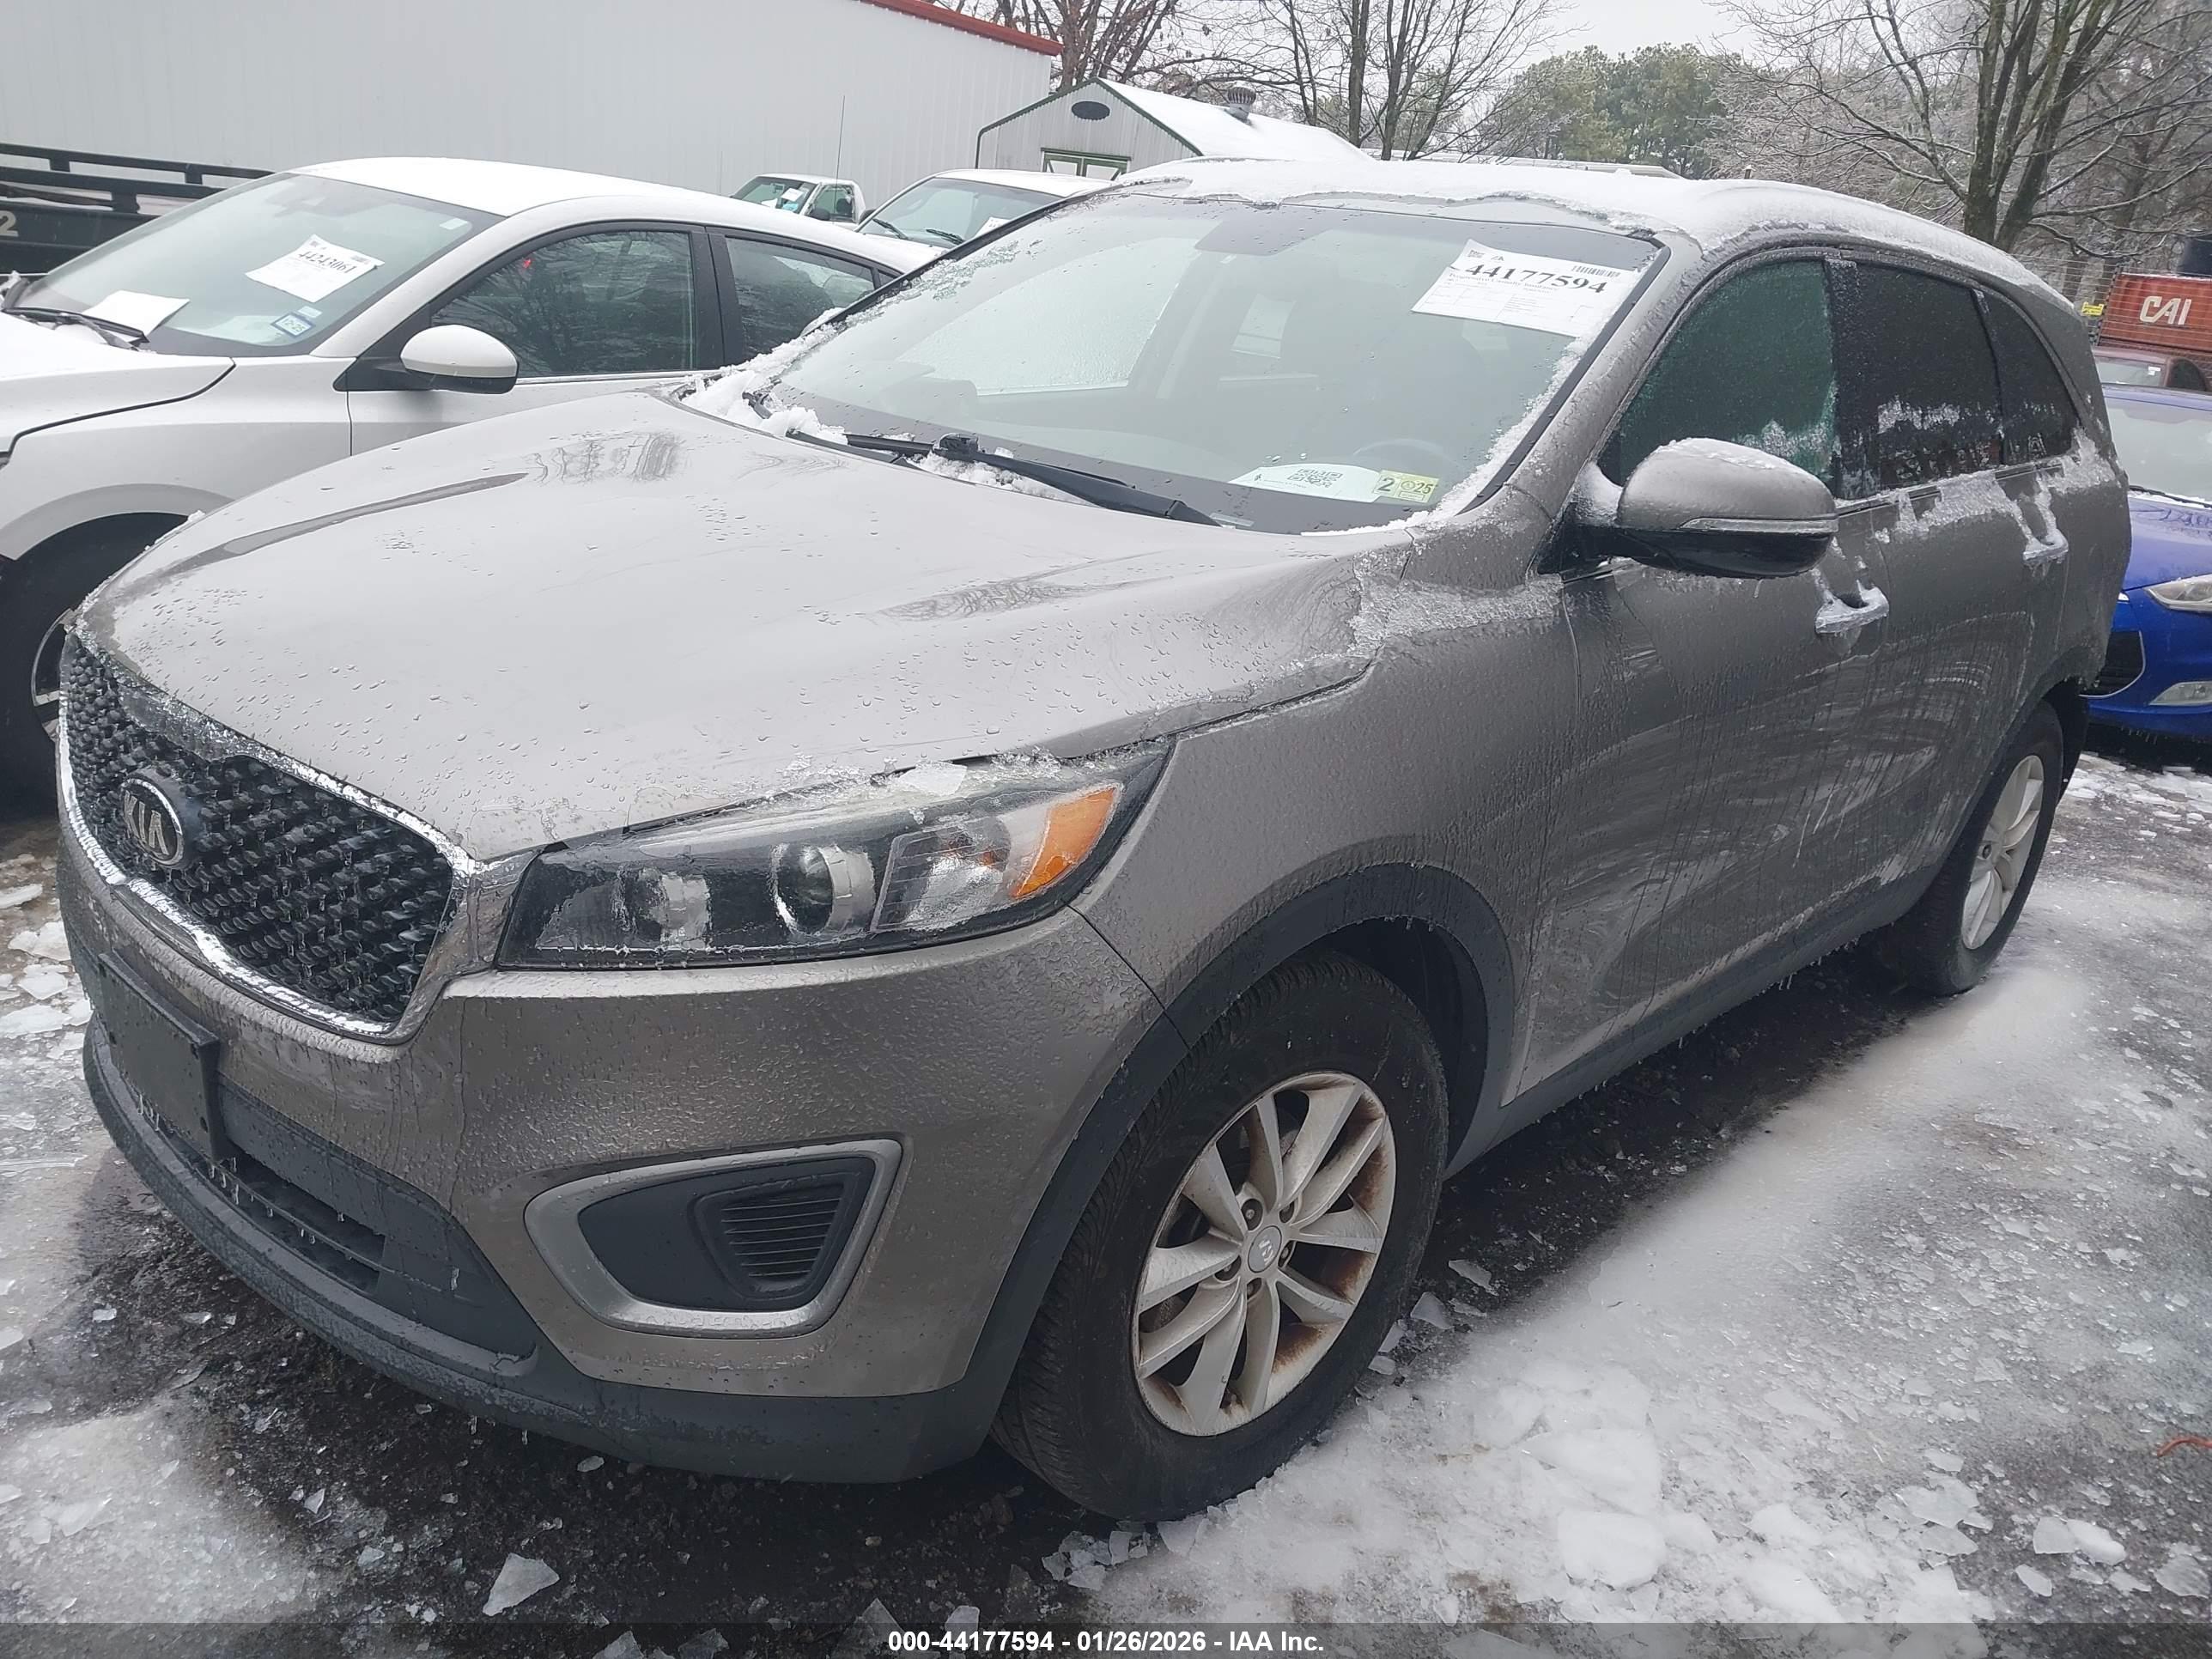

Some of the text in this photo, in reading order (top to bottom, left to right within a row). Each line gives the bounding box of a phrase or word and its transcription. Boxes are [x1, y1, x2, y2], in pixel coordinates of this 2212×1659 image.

[1465, 264, 1607, 294] 44177594
[2140, 295, 2192, 325] CAI
[1377, 477, 1434, 495] 2 25
[124, 789, 170, 856] KIA
